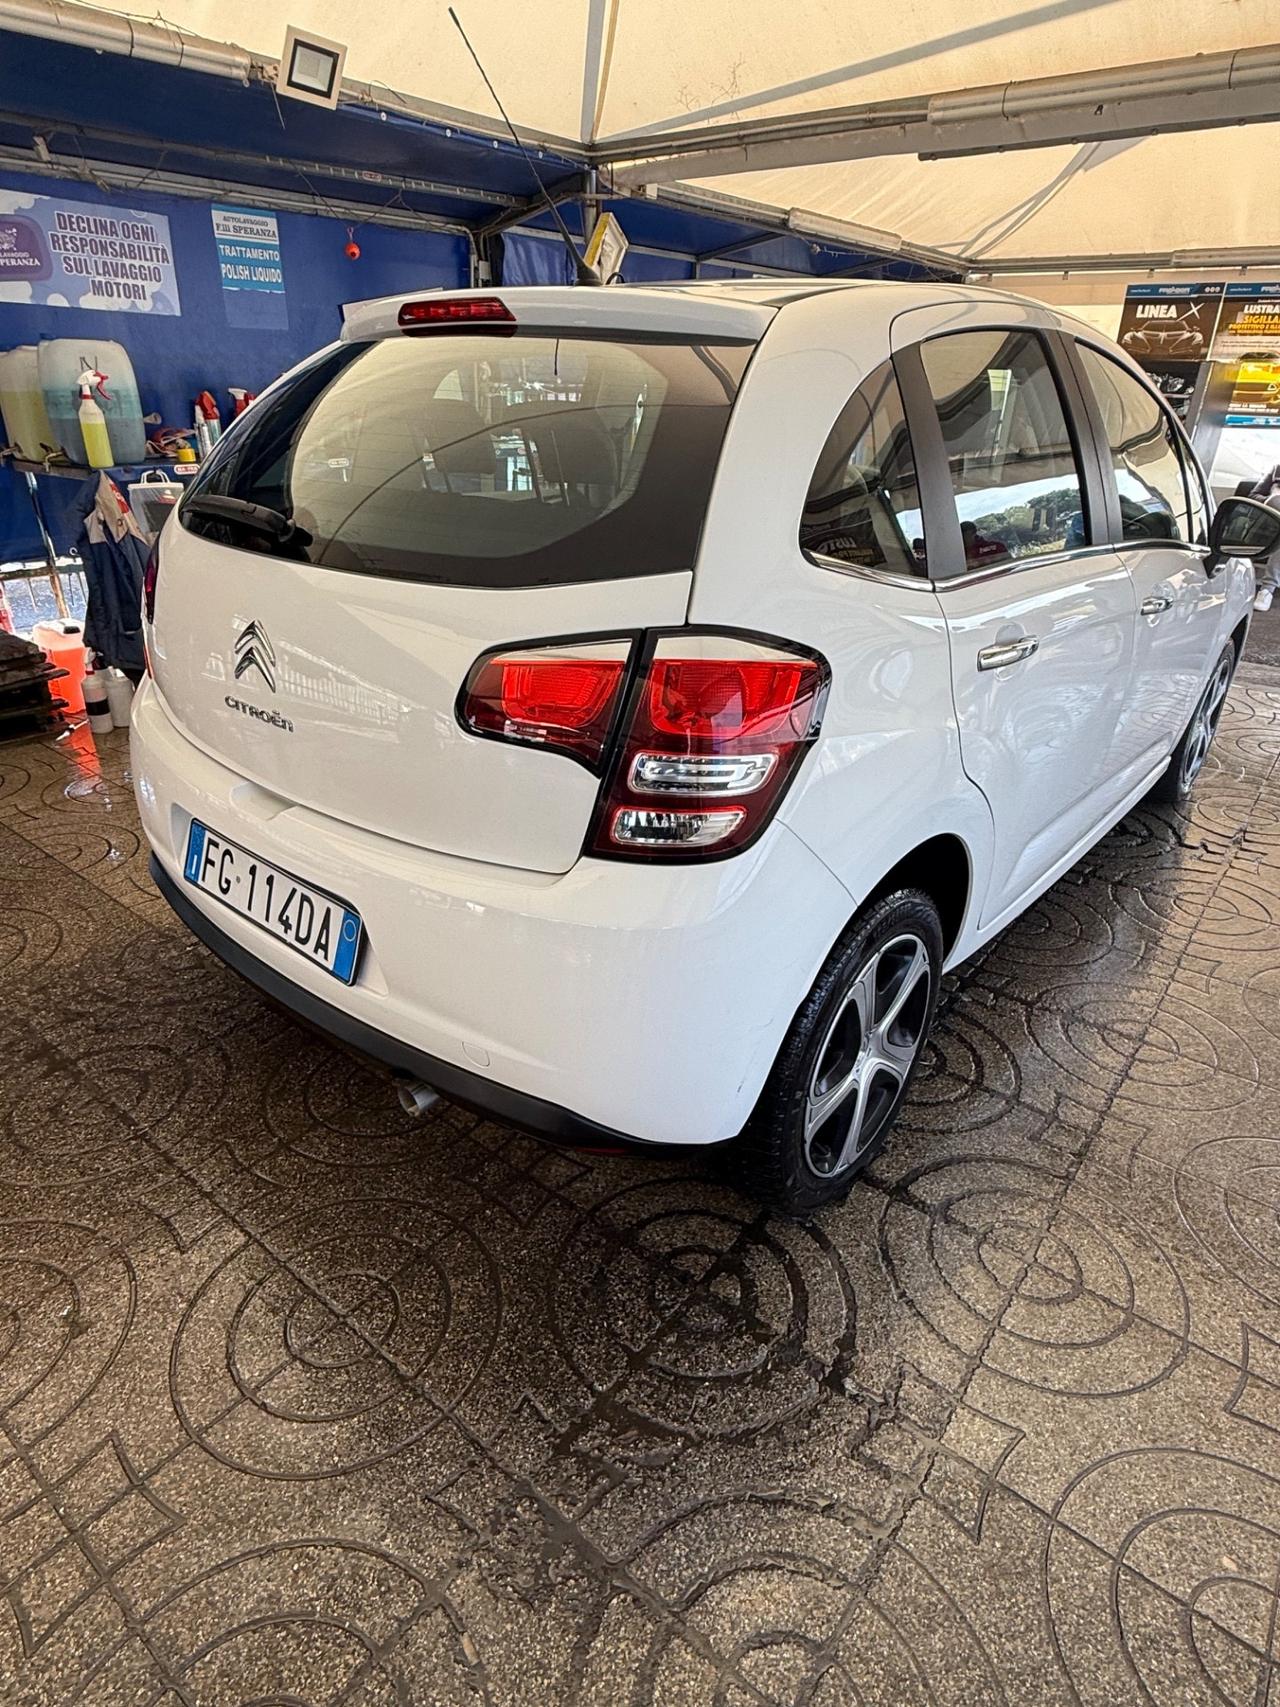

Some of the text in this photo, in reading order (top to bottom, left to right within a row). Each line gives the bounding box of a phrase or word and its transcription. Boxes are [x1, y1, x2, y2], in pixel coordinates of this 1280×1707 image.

[56, 212, 156, 242] DECLINA OGNI
[232, 224, 277, 239] SPERANZA
[49, 232, 170, 265] RESPONSABILITÀ
[218, 244, 280, 262] TRATTAMENTO
[62, 255, 162, 283] SUL LAVAGGIO
[220, 263, 282, 283] POLISH LIQUIDO
[90, 279, 148, 301] MOTORI
[1136, 304, 1178, 319] LINEA
[1243, 314, 1280, 324] SIGILLA
[200, 835, 236, 896] FG
[246, 862, 333, 962] 114DA
